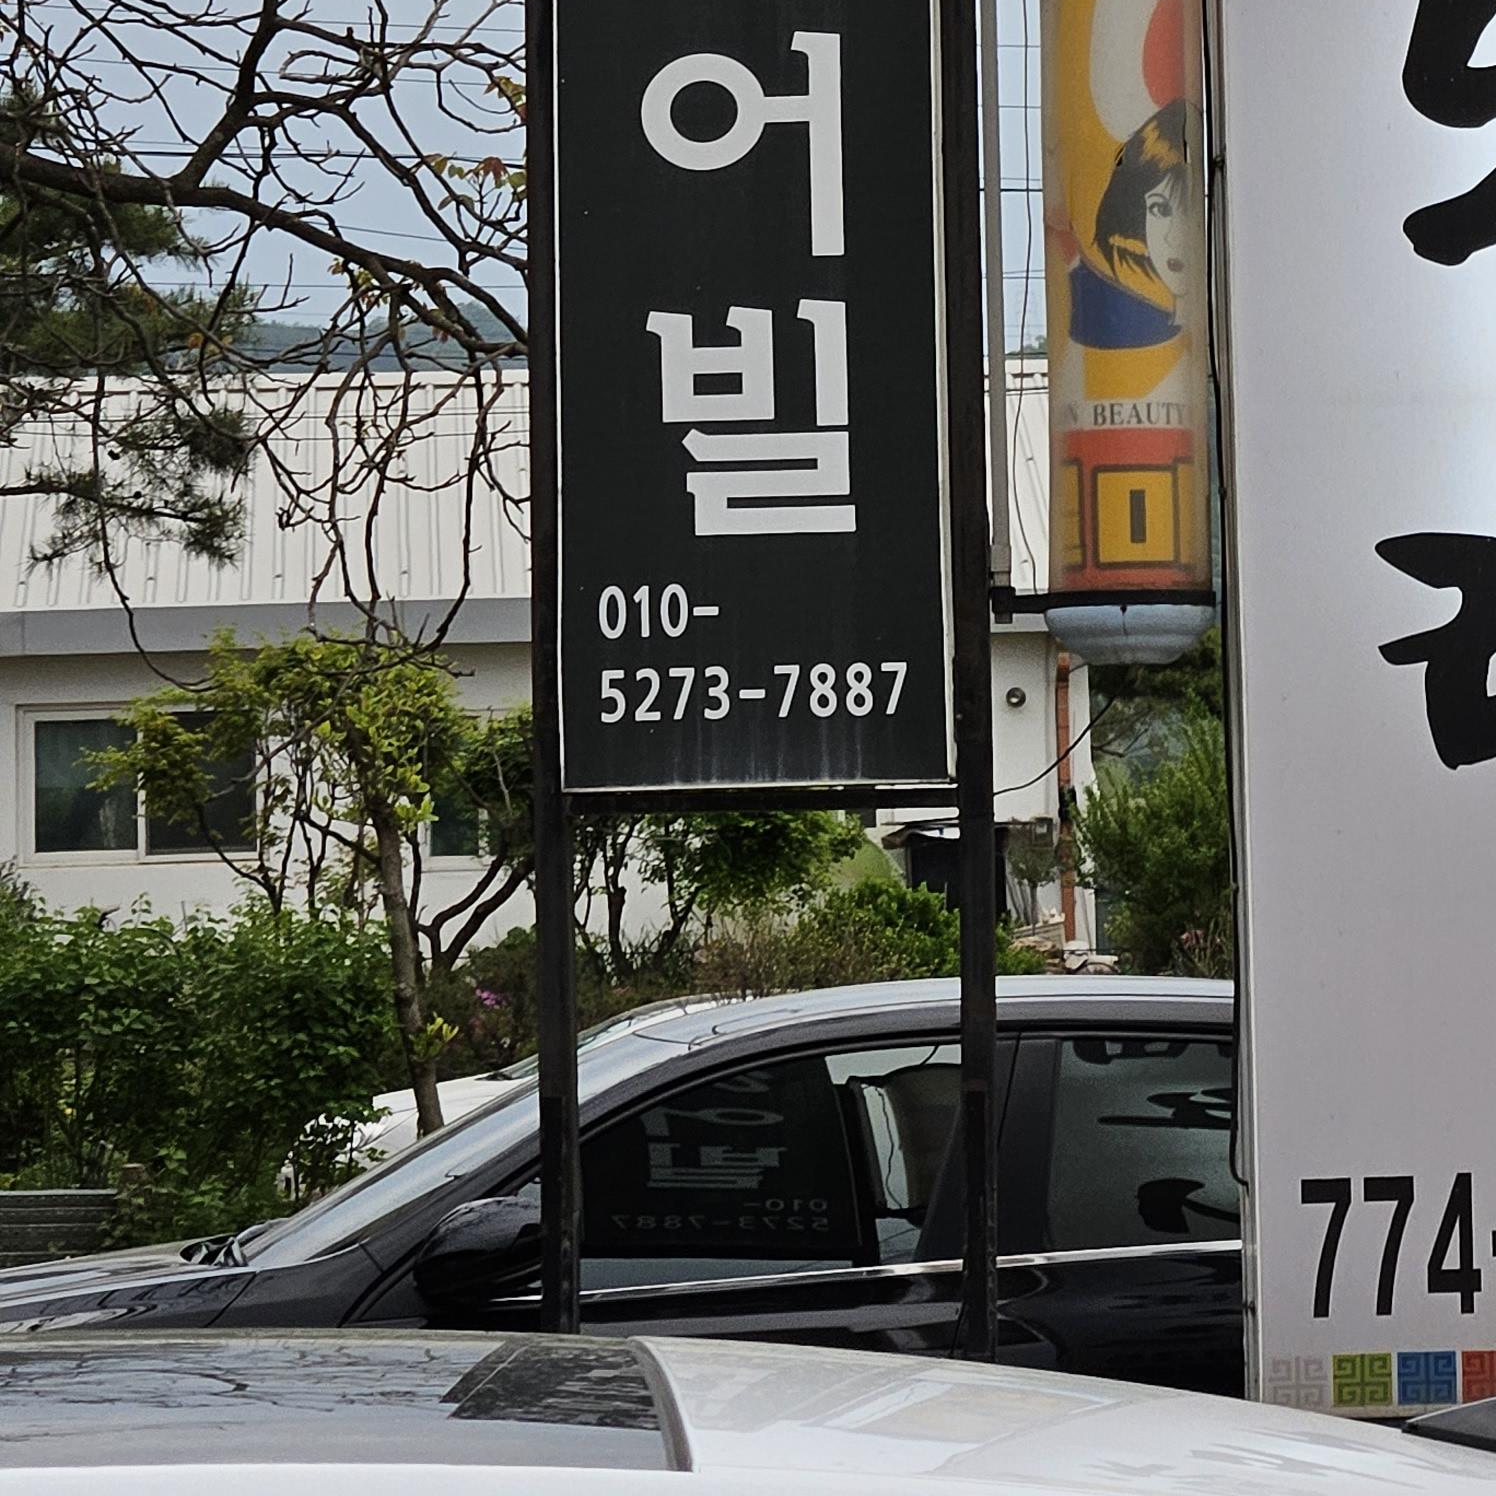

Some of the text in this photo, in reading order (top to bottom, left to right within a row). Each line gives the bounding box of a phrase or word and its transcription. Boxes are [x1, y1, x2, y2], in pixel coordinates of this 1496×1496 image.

[1092, 401, 1185, 426] BEAUTY
[599, 584, 719, 638] 010-
[600, 661, 907, 723] 5273-7887
